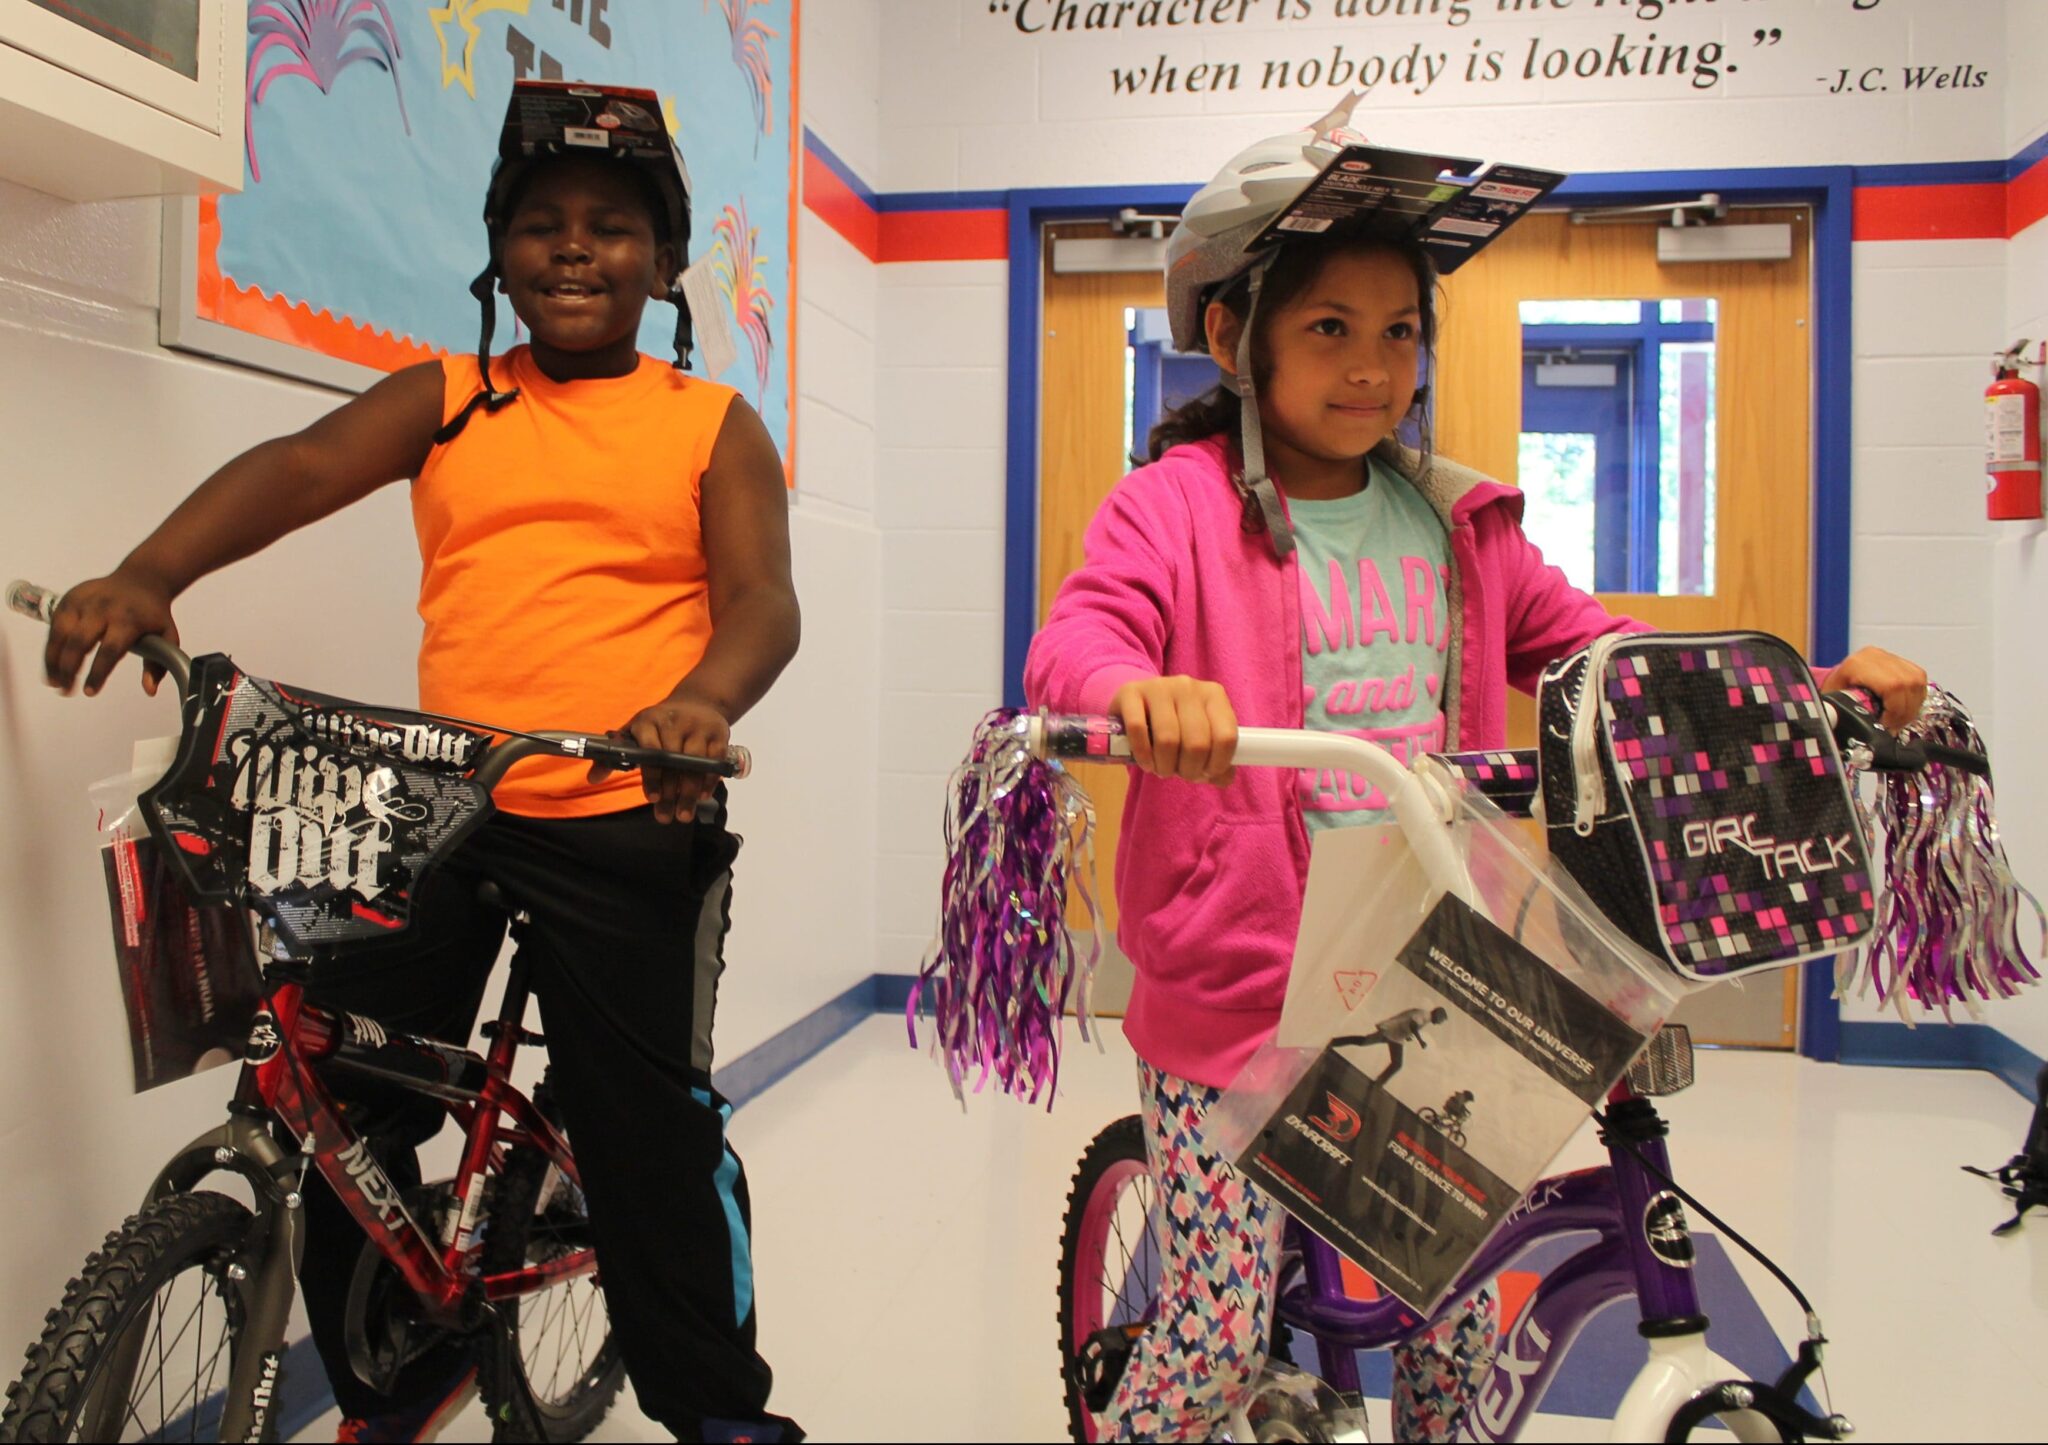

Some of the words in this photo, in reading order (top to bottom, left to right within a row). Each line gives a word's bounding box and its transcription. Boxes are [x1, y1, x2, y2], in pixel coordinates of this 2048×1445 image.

[1110, 54, 1241, 96] when
[1261, 43, 1447, 95] nobody
[1464, 38, 1505, 82] is
[1901, 64, 1988, 91] Wells
[1325, 663, 1418, 716] and
[1752, 833, 1856, 881] TACK
[1428, 946, 1489, 997] WELCOME
[1488, 990, 1506, 1010] TO
[1507, 1006, 1535, 1031] OUR
[1534, 1025, 1595, 1076] UNIVERSE
[1387, 1140, 1409, 1160] FOR
[1414, 1160, 1455, 1195] CHANCE
[1451, 1187, 1465, 1203] TO
